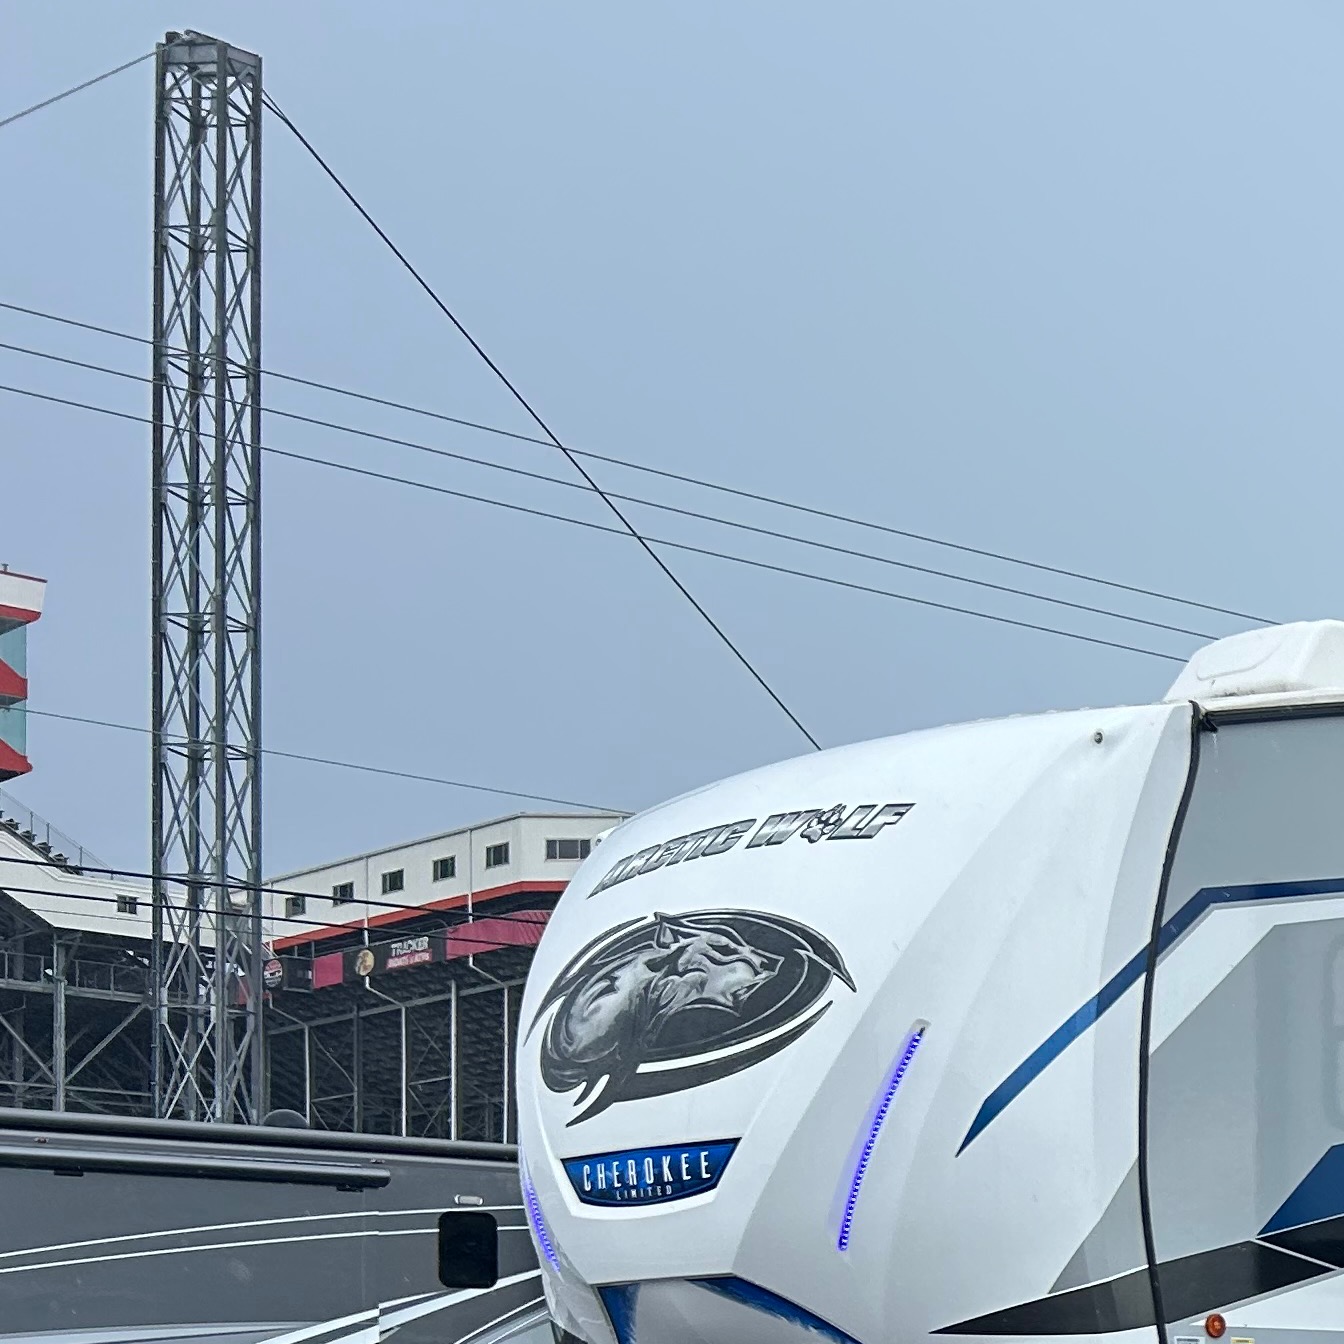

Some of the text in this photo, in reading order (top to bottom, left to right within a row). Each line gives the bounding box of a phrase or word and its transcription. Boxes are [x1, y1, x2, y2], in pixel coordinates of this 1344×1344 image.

[586, 819, 757, 899] ARCTIC
[583, 1151, 711, 1191] CHEROKEE
[616, 1185, 672, 1200] LIMITED
